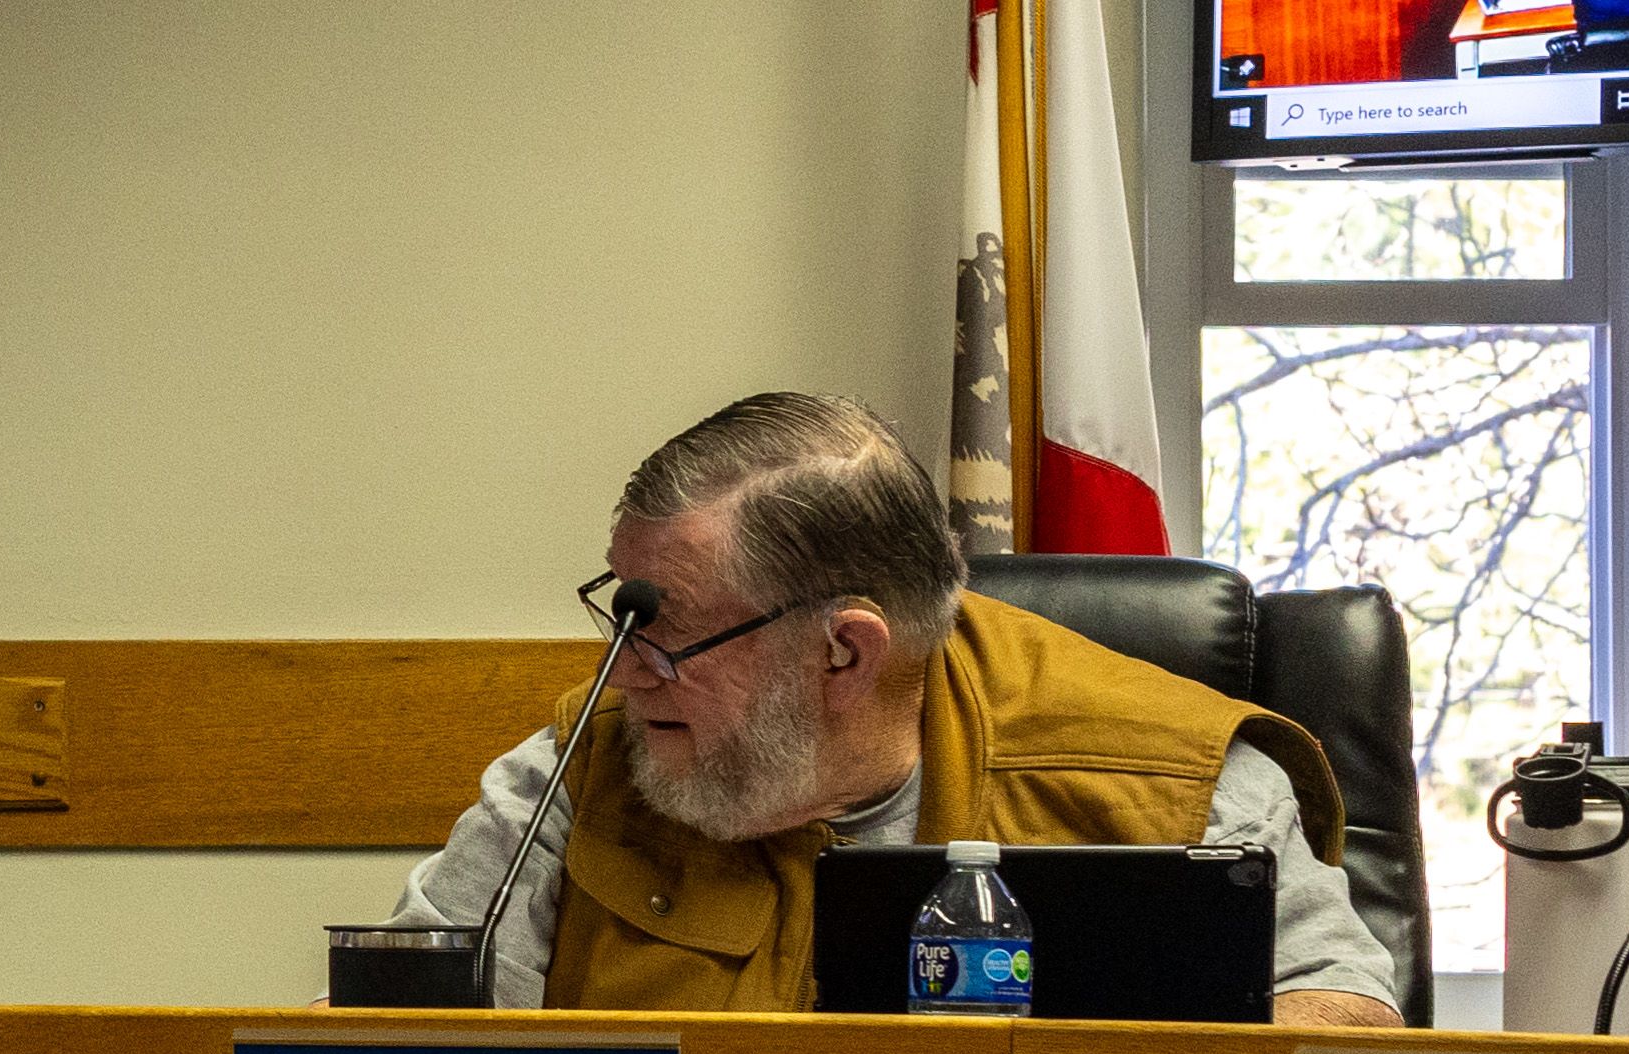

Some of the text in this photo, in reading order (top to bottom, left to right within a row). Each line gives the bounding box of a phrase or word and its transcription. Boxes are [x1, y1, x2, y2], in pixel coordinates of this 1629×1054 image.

[1318, 101, 1468, 125] Type here to search
[916, 942, 950, 960] Pure
[919, 960, 945, 981] Life
